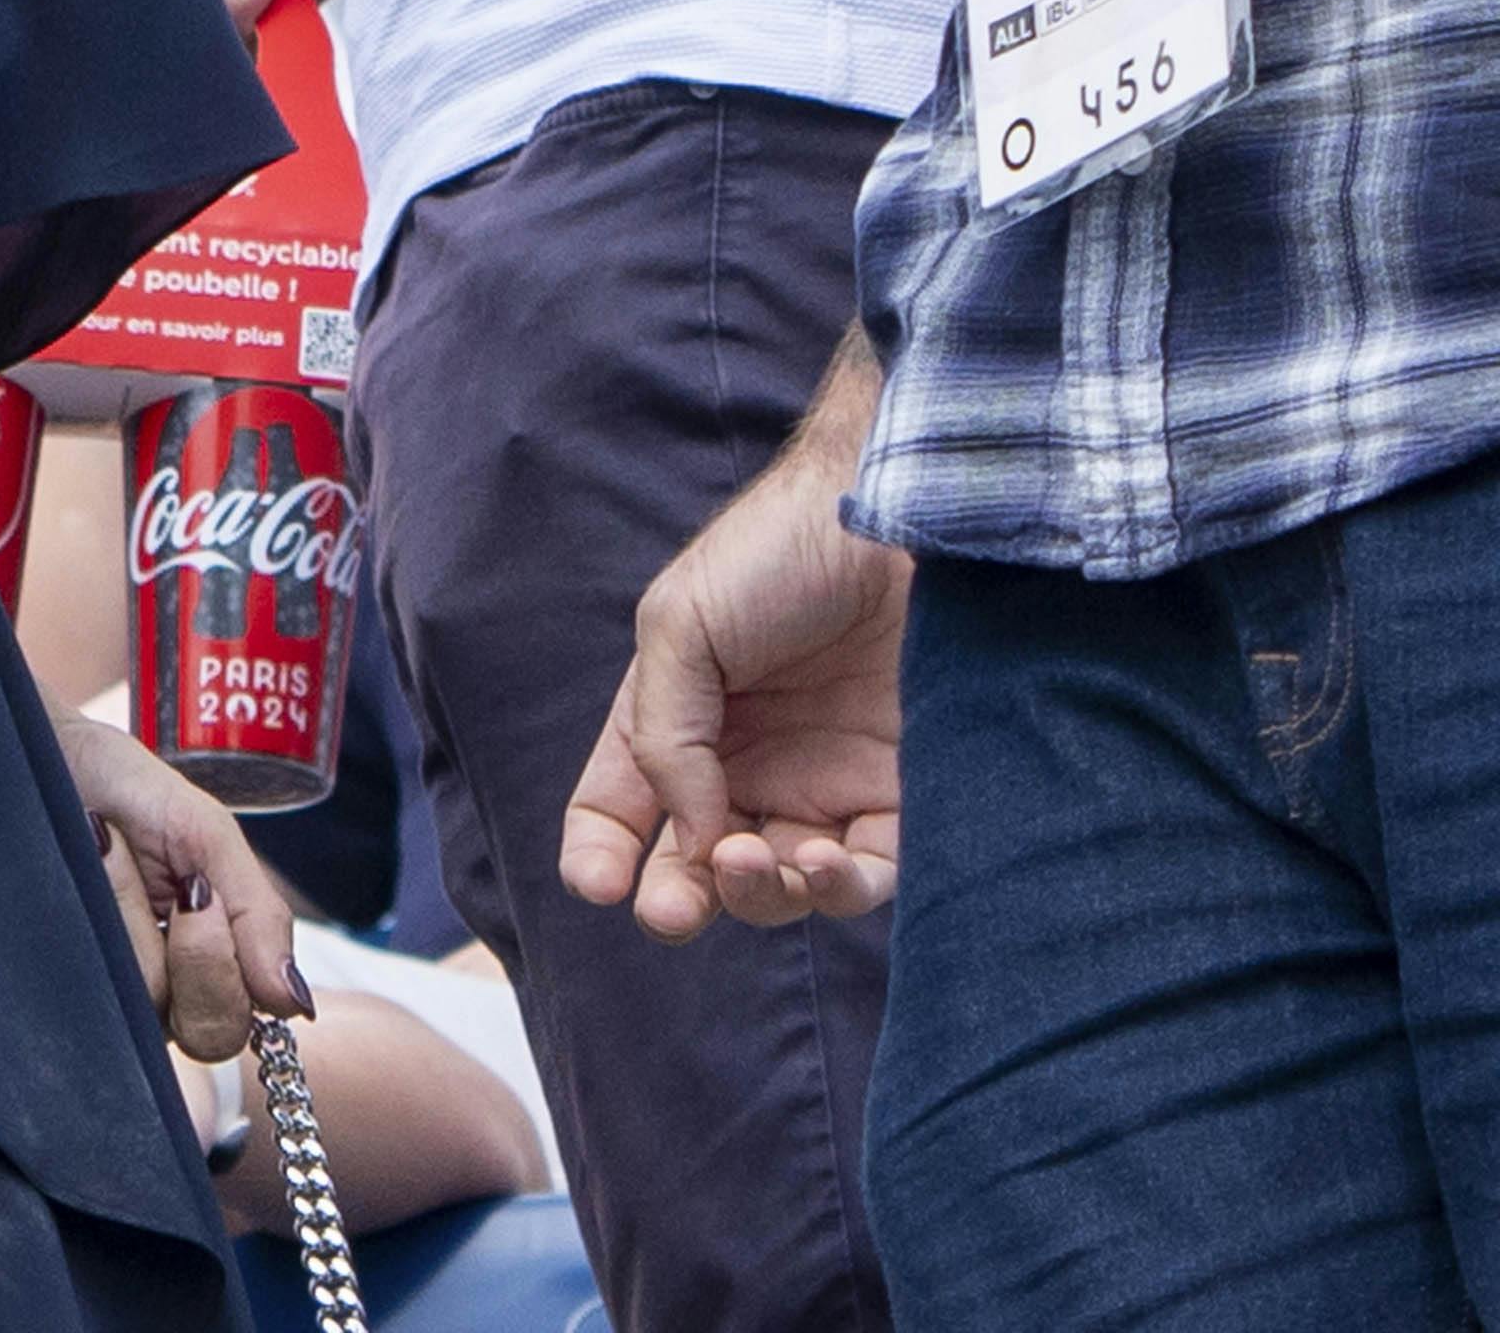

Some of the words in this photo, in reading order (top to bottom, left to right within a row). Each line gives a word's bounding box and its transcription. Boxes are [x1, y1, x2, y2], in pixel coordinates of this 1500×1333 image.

[994, 16, 1034, 51] ALL
[144, 268, 281, 303] poubelle
[126, 315, 157, 334] en
[159, 317, 231, 342] savoir
[235, 324, 285, 348] plus
[199, 656, 310, 698] PARIS
[198, 690, 308, 733] 2024
